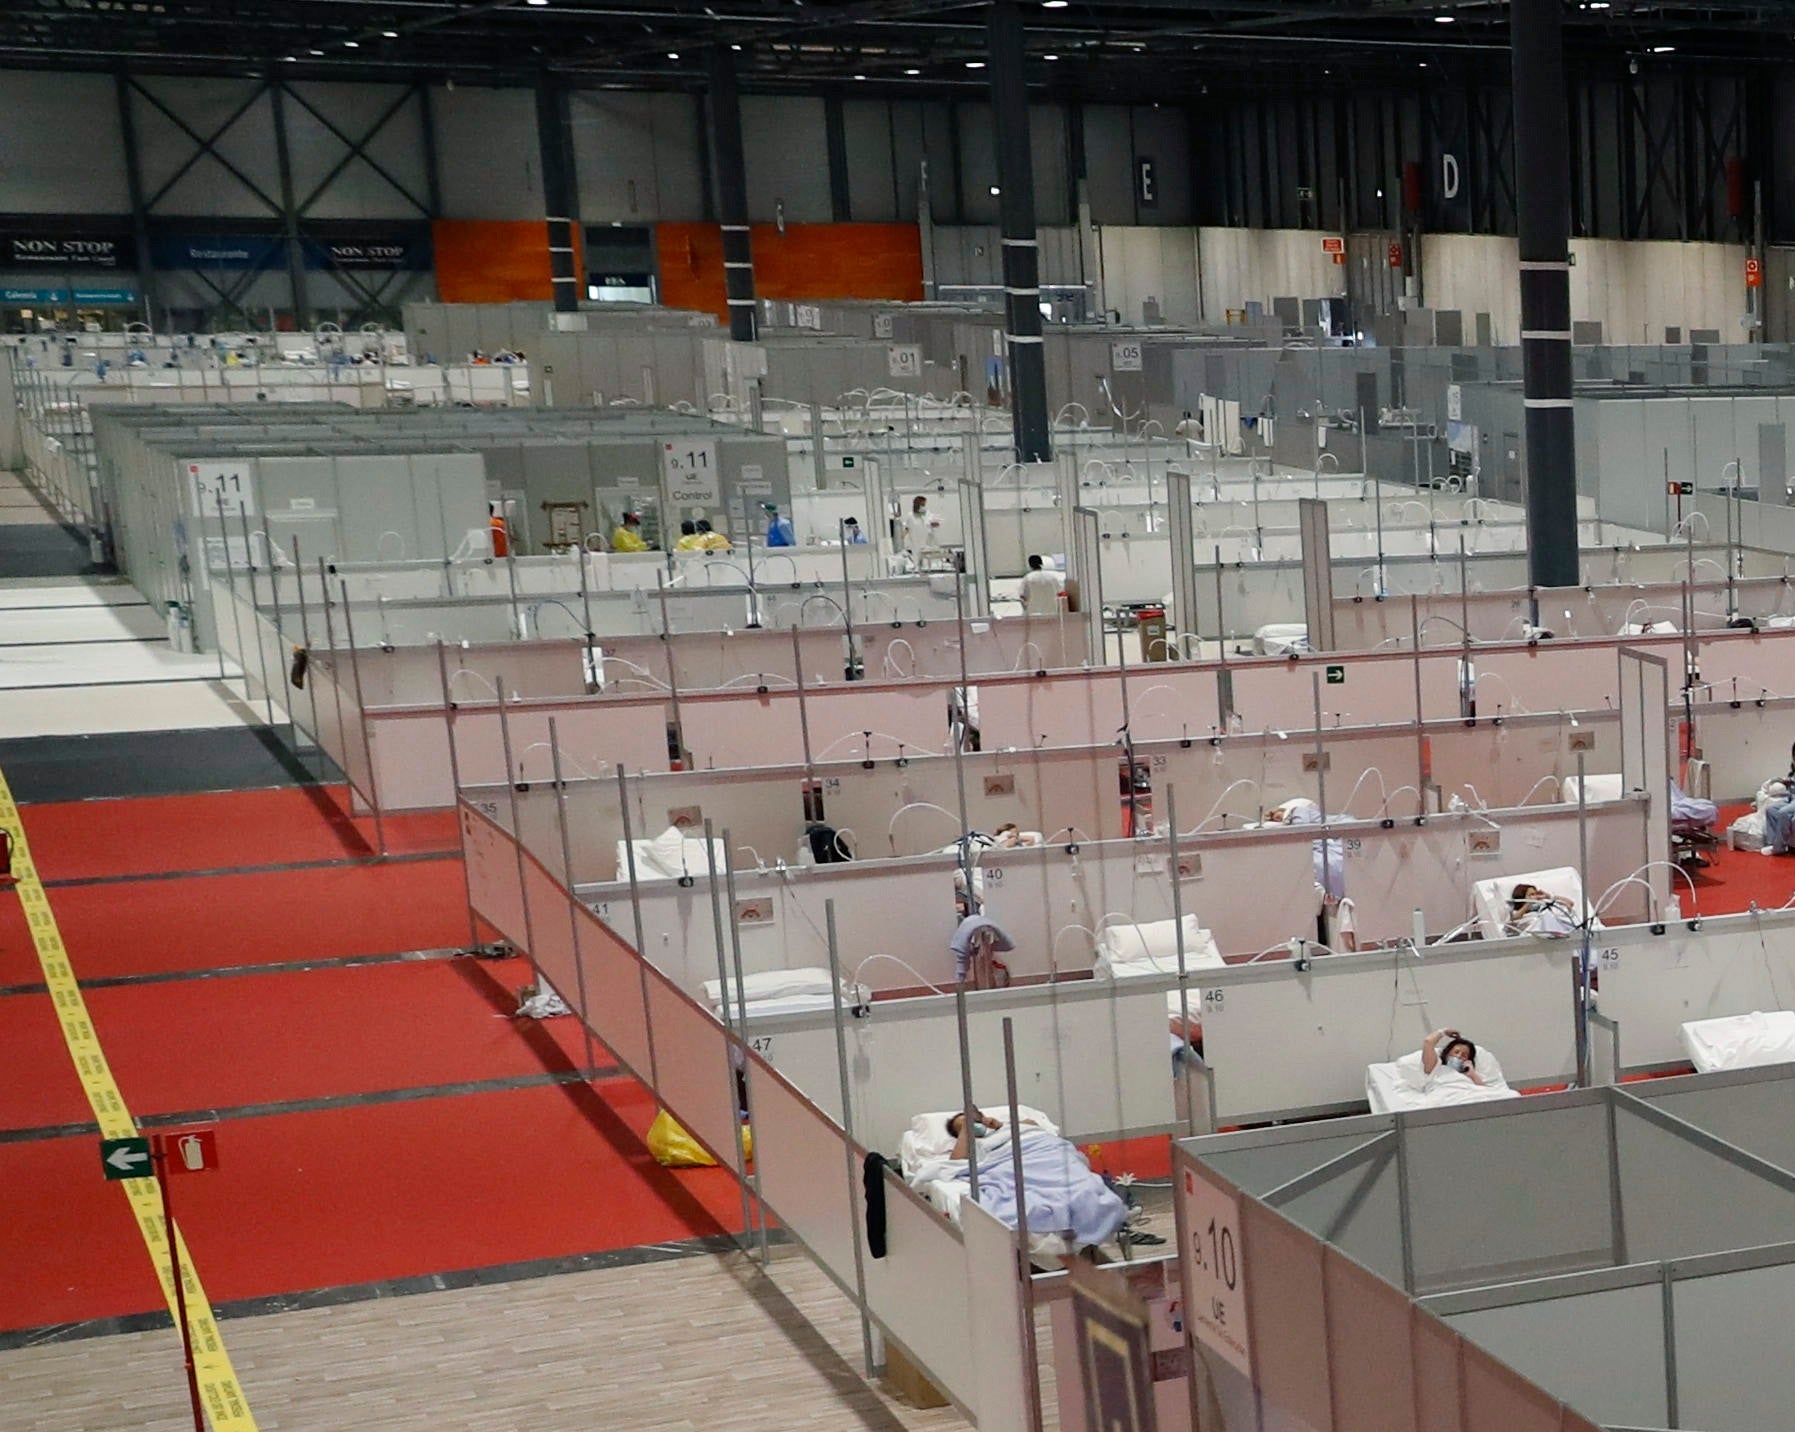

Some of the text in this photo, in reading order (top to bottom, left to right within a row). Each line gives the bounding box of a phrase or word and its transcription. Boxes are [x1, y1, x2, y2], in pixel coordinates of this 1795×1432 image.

[1142, 163, 1153, 200] E
[1443, 154, 1459, 199] D
[13, 240, 114, 253] NON STOP
[671, 451, 708, 469] 9.11
[672, 490, 713, 501] Control
[1346, 839, 1361, 850] 39
[987, 869, 1003, 880] 40
[1602, 949, 1618, 960] 45
[1205, 990, 1224, 1002] 46
[753, 1038, 772, 1051] 47
[1193, 1217, 1236, 1290] 9.10
[1212, 1296, 1226, 1325] UE
